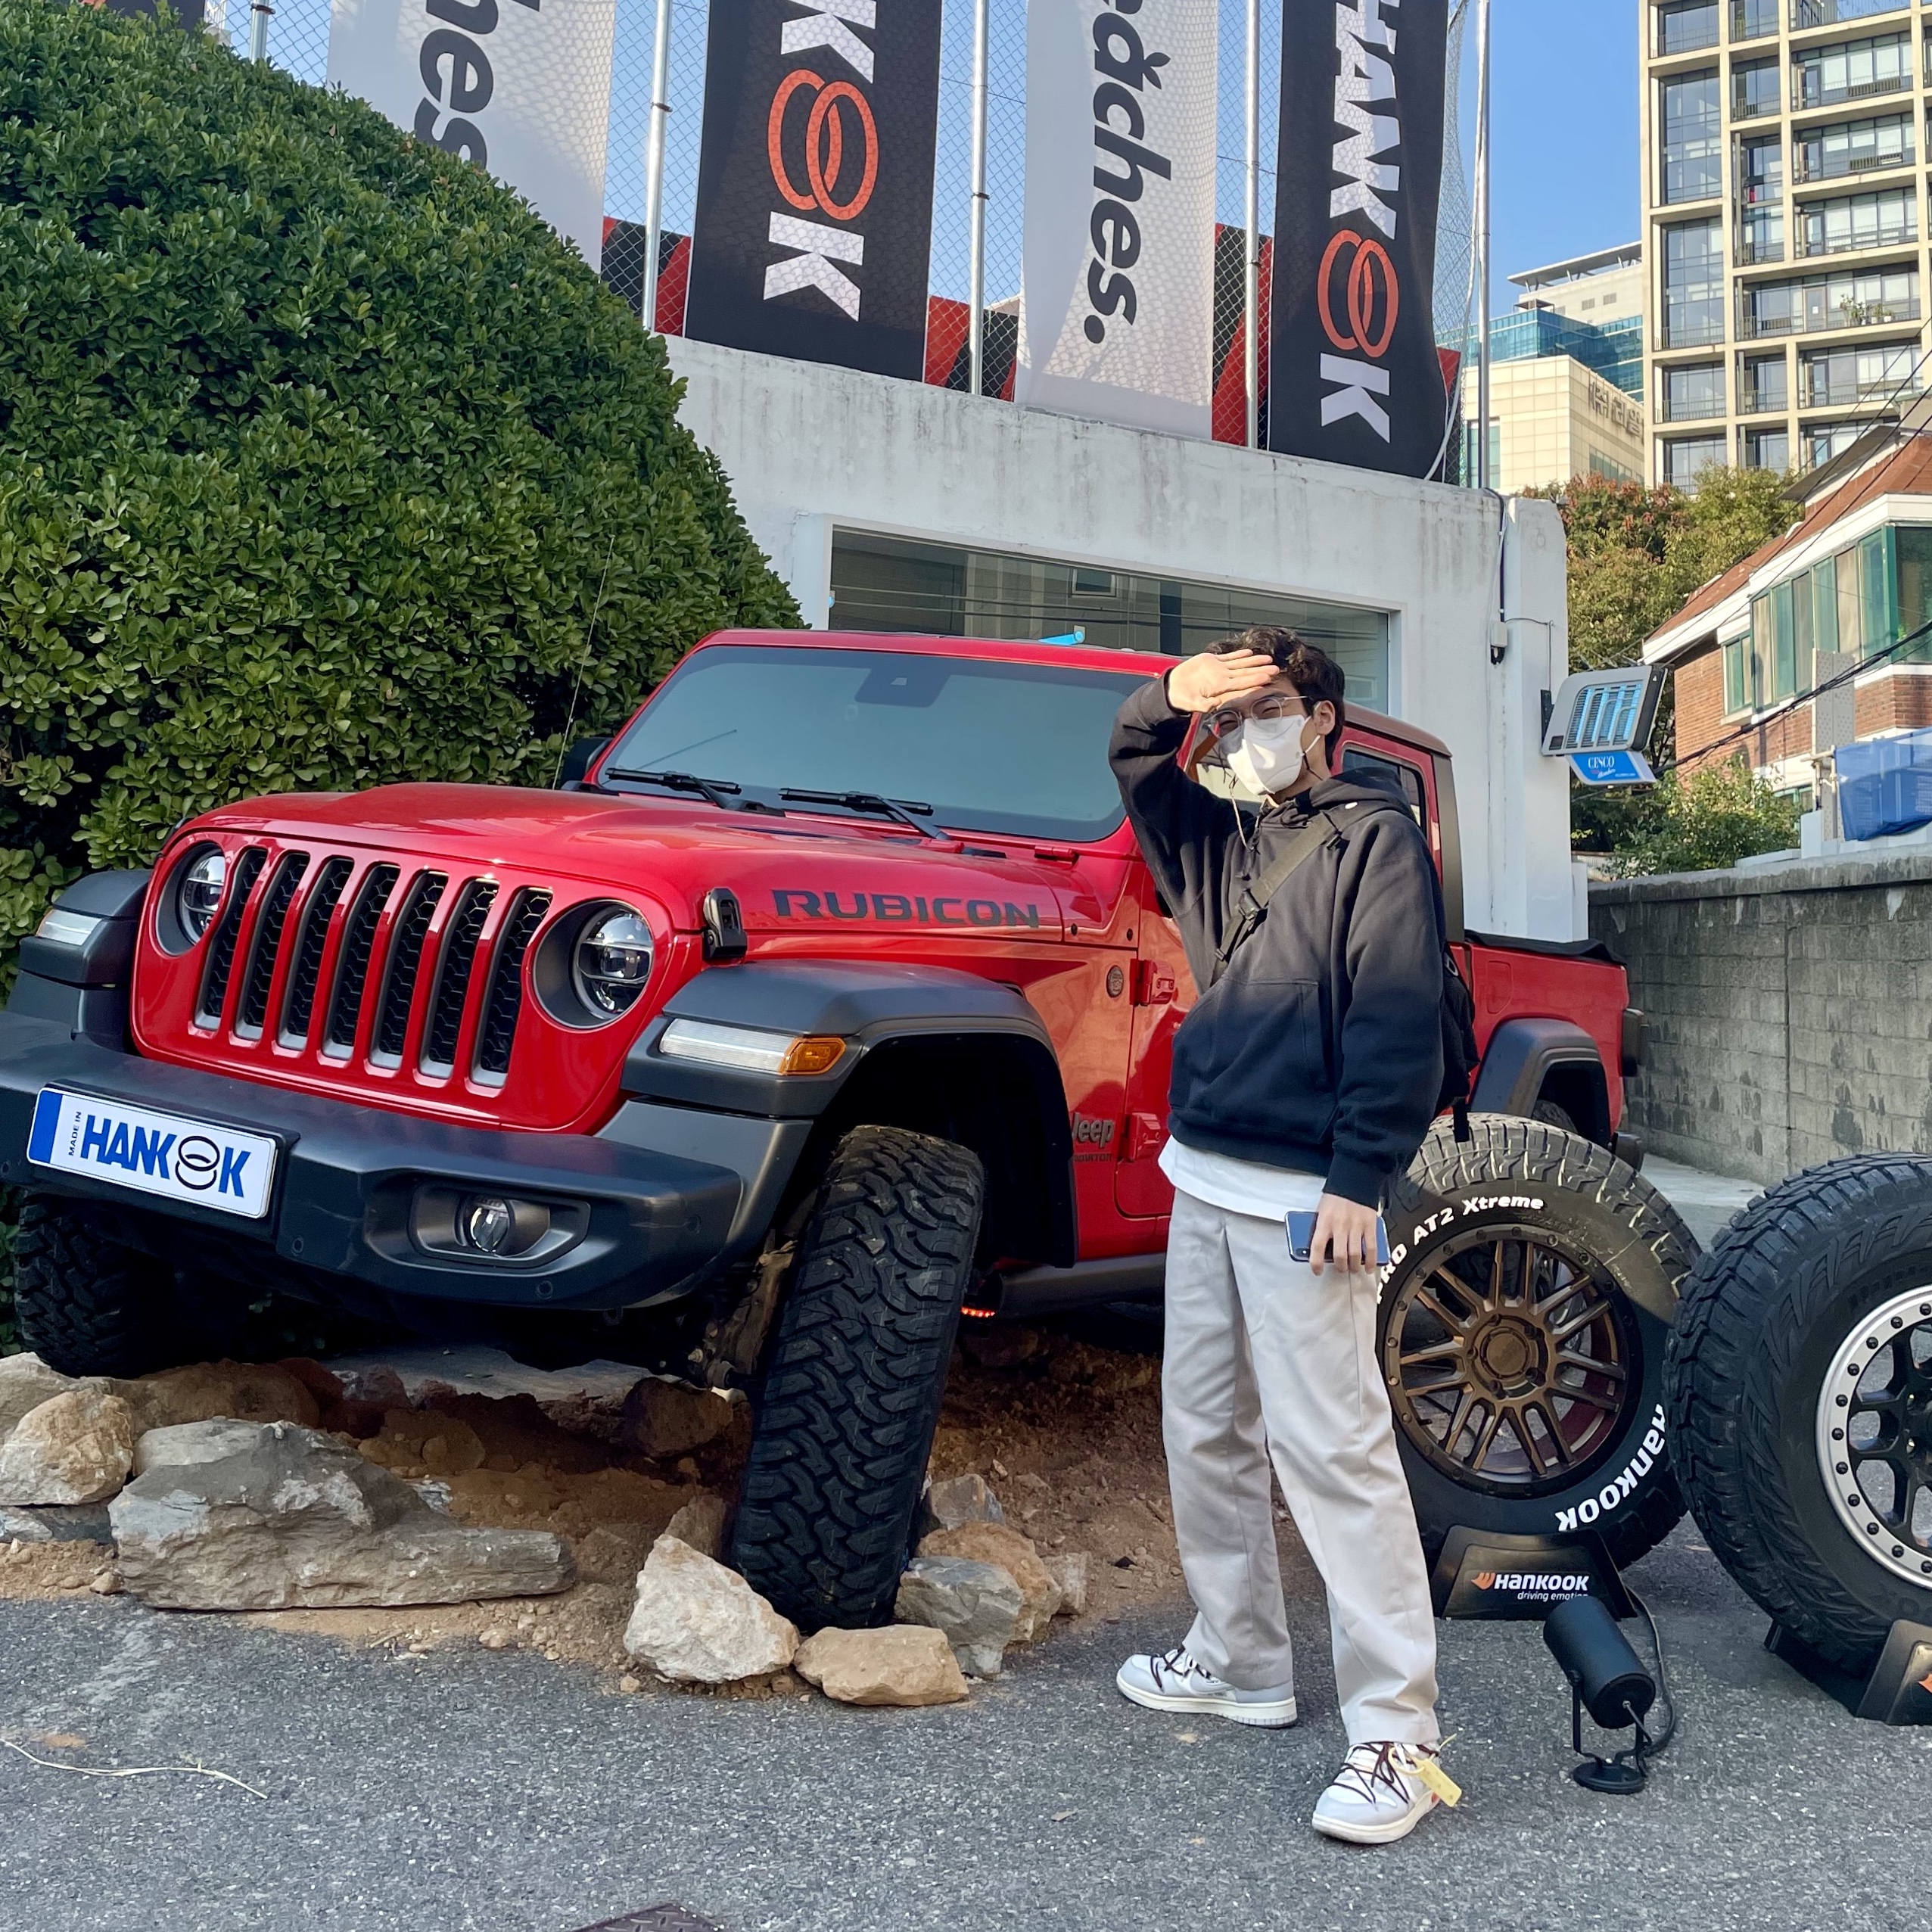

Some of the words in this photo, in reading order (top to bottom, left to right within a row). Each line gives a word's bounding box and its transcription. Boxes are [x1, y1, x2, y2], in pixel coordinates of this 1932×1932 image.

[1084, 0, 1171, 344] aches.
[1588, 755, 1615, 769] CESCO
[773, 889, 1040, 929] RUBICON
[68, 1125, 79, 1156] MADE
[75, 1111, 81, 1122] IN
[1072, 1112, 1115, 1148] Jeep
[1414, 1207, 1455, 1246] AT2
[1462, 1196, 1545, 1215] Xtreme
[1517, 1591, 1549, 1602] driving
